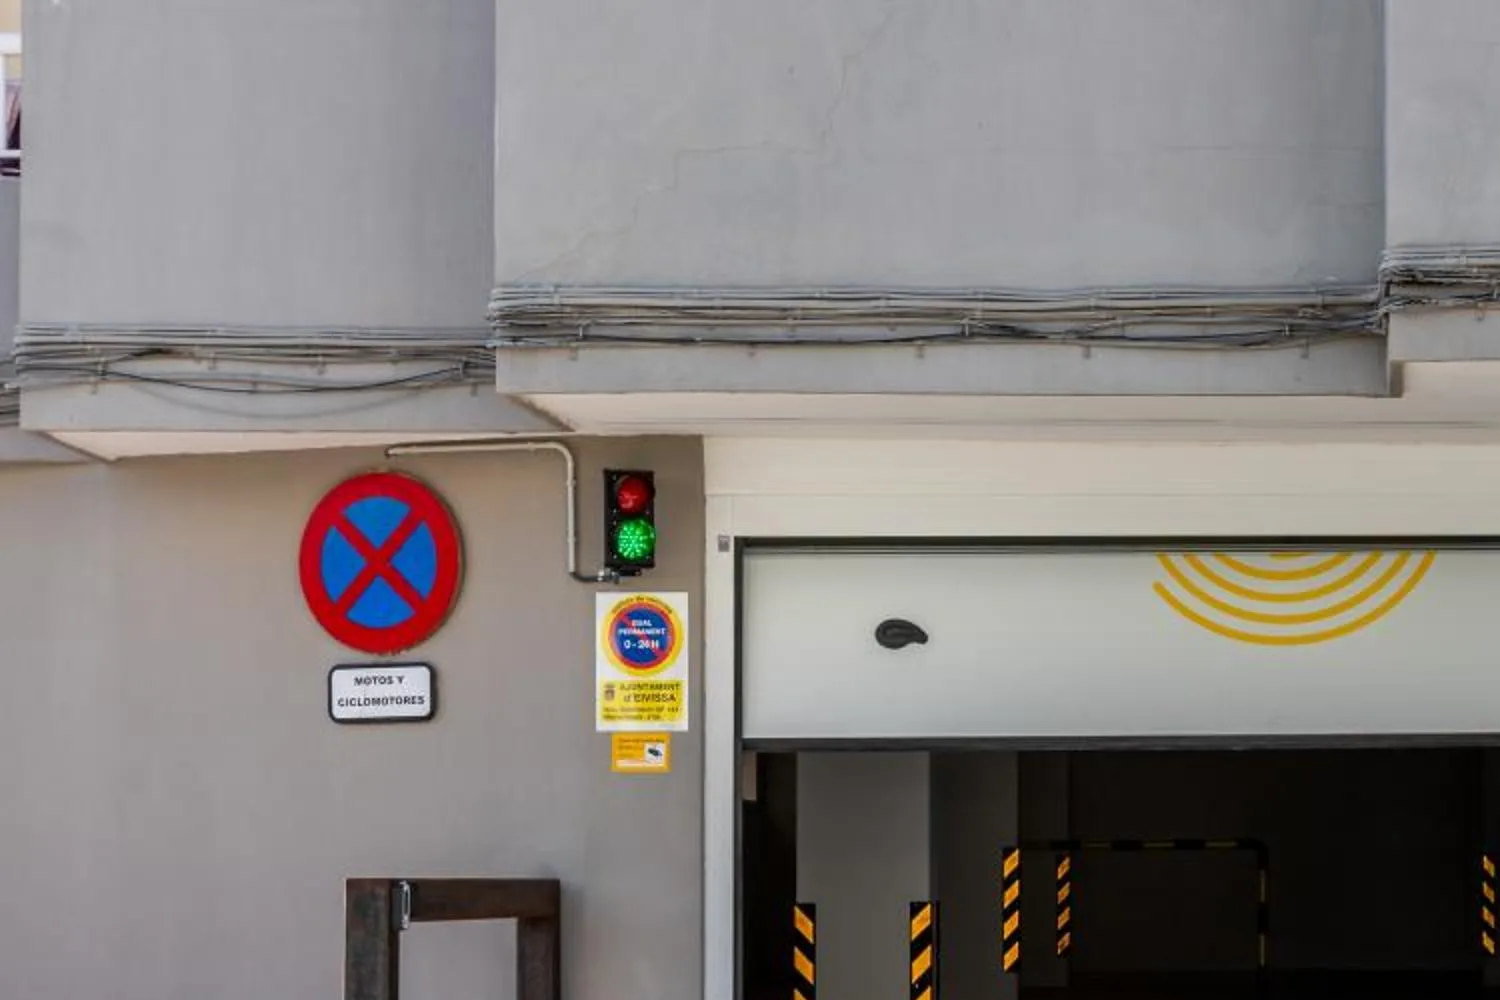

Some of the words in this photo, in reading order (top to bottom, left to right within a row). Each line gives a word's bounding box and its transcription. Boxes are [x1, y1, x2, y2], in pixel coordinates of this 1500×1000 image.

[353, 676, 394, 686] MOTOS
[396, 675, 405, 684] Y
[337, 695, 425, 707] CICLOMOTORES
